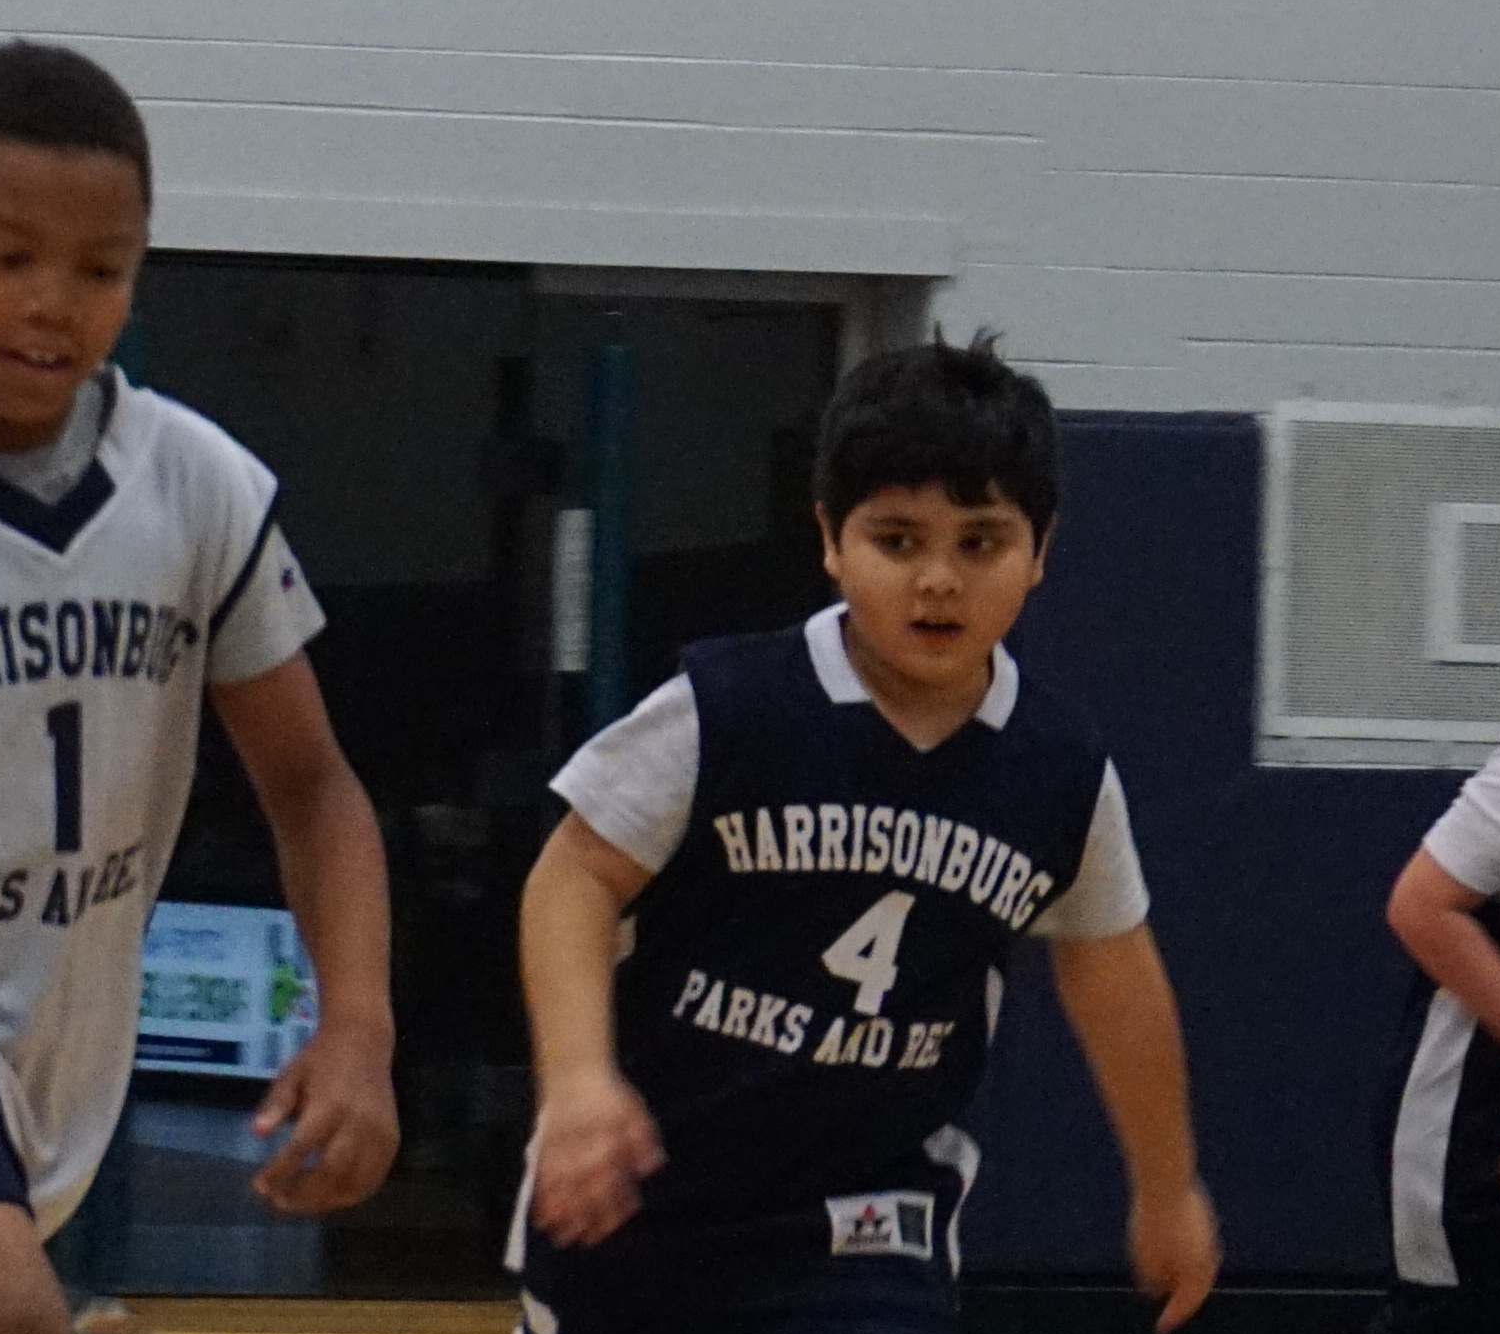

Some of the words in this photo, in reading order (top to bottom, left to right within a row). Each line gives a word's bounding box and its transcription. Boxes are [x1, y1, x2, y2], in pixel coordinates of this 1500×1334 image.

[46, 700, 82, 853] 1
[713, 802, 1054, 931] HARRISONBURG
[672, 968, 815, 1055] PARKS
[820, 889, 916, 1016] 4
